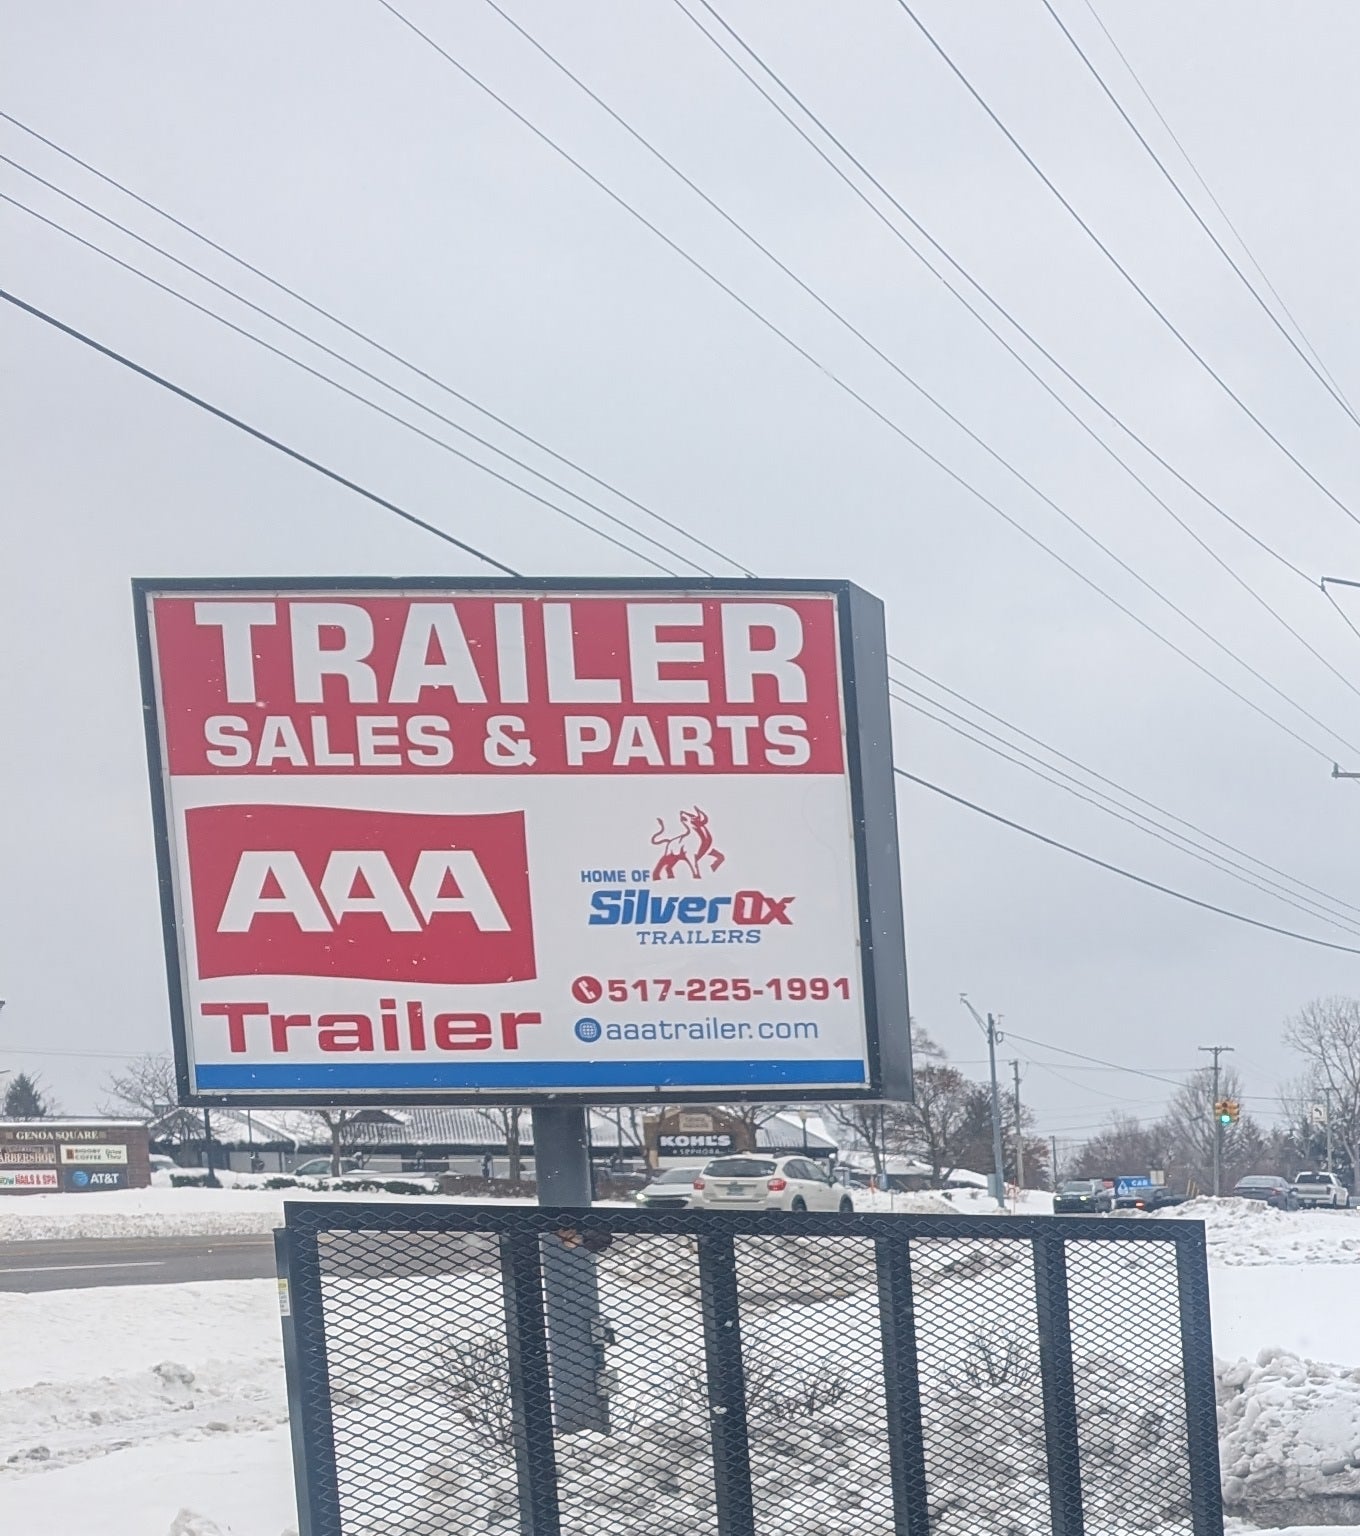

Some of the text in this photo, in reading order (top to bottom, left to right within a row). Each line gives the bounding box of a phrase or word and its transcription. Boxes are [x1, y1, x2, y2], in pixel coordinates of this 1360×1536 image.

[194, 601, 809, 705] TRAILER
[204, 714, 812, 768] SALES & PARTS
[580, 868, 652, 884] HOME OF
[217, 850, 513, 934] AAA
[636, 929, 762, 946] TRAILERS
[607, 976, 851, 1004] 517-225-1991
[200, 998, 542, 1054] Trailer
[605, 1016, 820, 1042] aaatrailer.com
[16, 1131, 98, 1140] GENOA SQUARE
[660, 1135, 731, 1147] KOHL'S
[90, 1173, 119, 1184] AT&T
